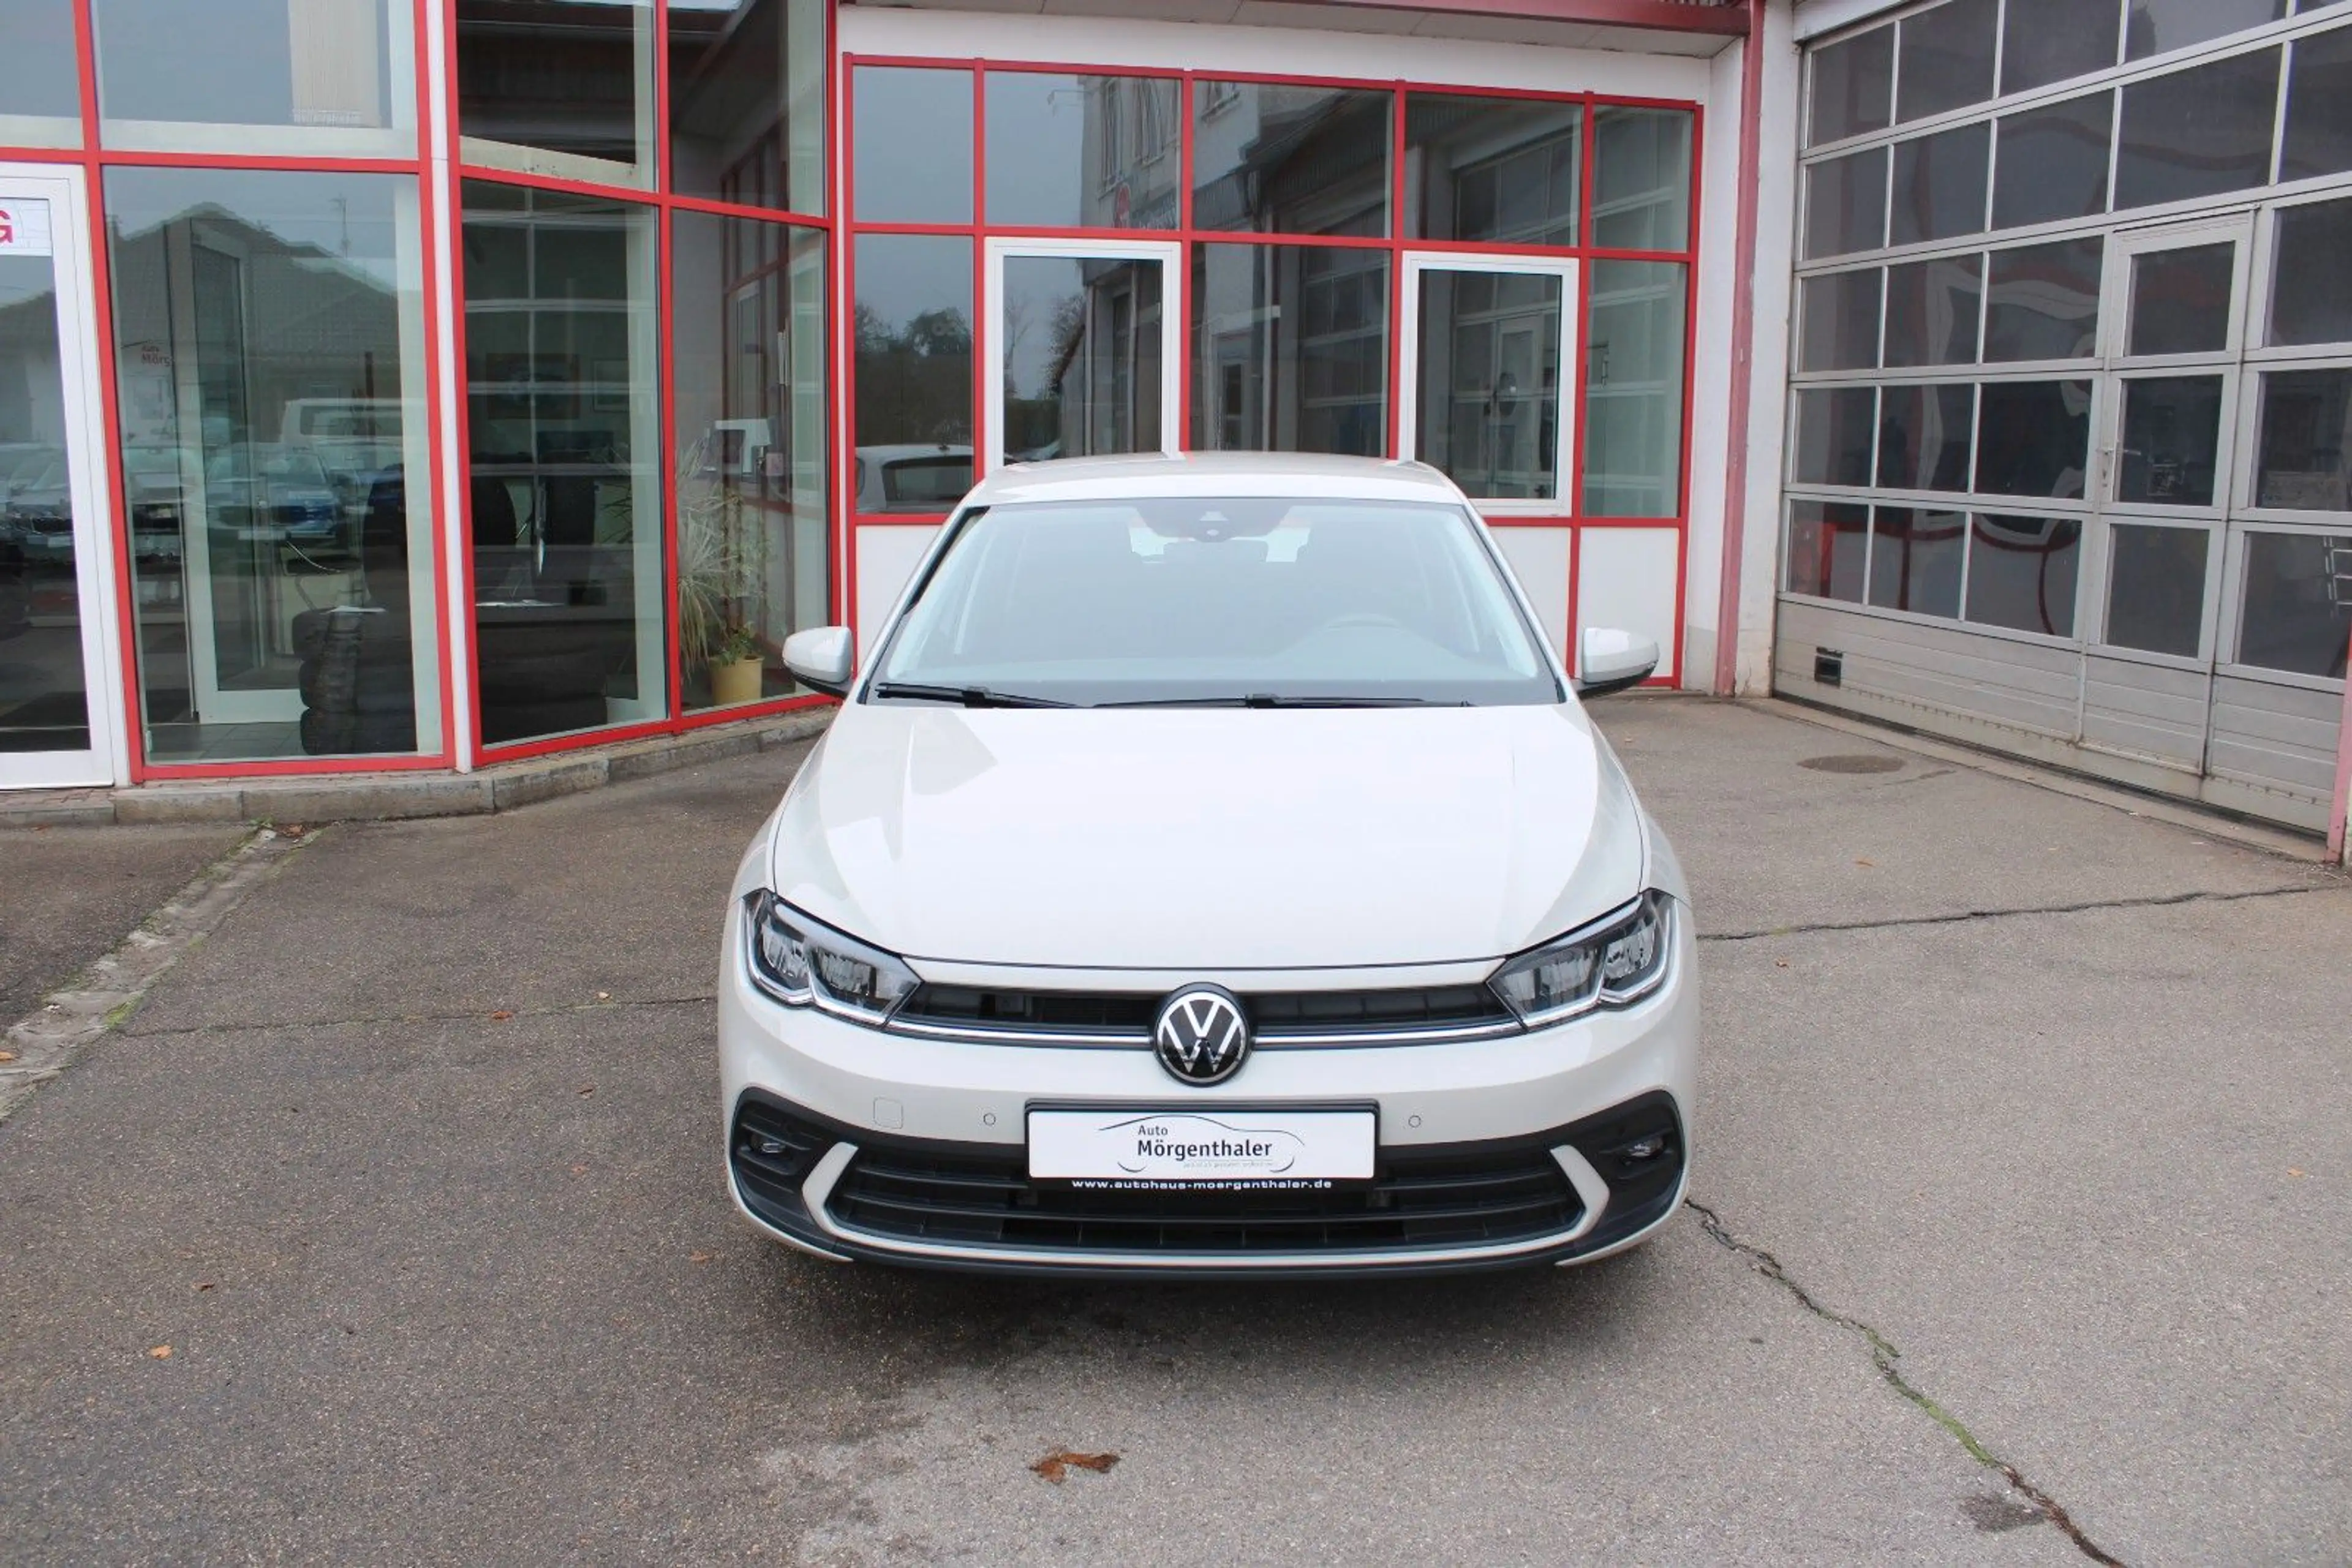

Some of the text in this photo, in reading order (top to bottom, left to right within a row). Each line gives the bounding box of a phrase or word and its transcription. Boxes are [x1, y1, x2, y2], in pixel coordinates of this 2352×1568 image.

[1159, 993, 1245, 1078] VW
[1137, 1125, 1169, 1136] Auto
[1137, 1139, 1273, 1161] Mörgenthaler
[1071, 1180, 1332, 1191] www.autohaus-moergenthaler.de
